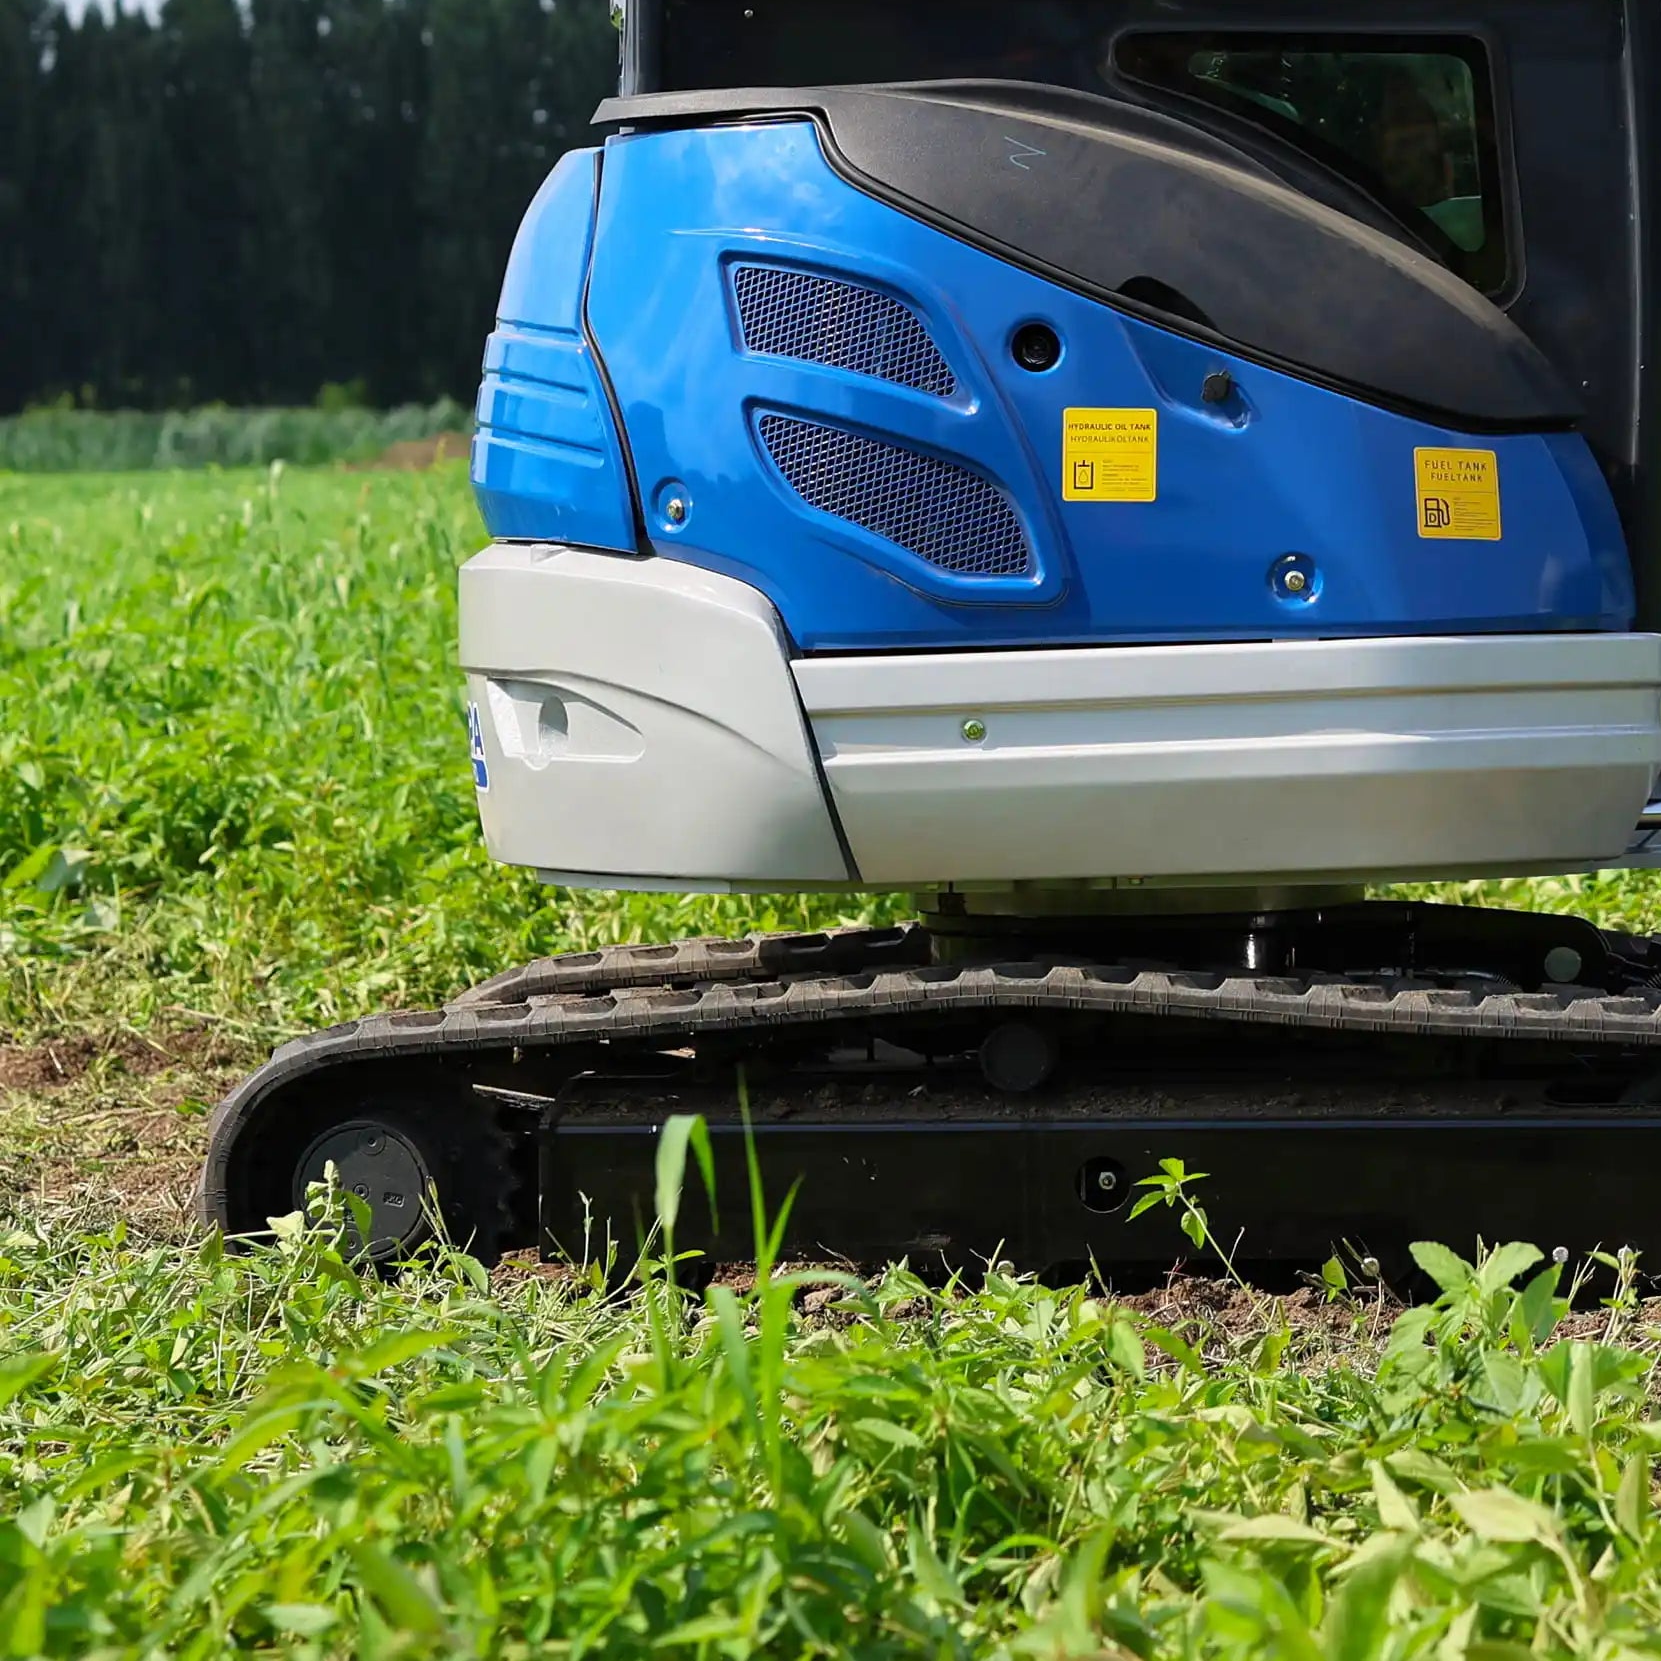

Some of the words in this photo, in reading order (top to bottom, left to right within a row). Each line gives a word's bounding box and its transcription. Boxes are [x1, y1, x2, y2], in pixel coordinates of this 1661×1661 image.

[1068, 423, 1113, 431] HYDRAULIC
[1114, 423, 1128, 431] OIL
[1130, 423, 1152, 431] TANK
[1424, 460, 1453, 470] FUEL
[1458, 461, 1488, 472] TANK
[1430, 472, 1483, 483] FUELTANK
